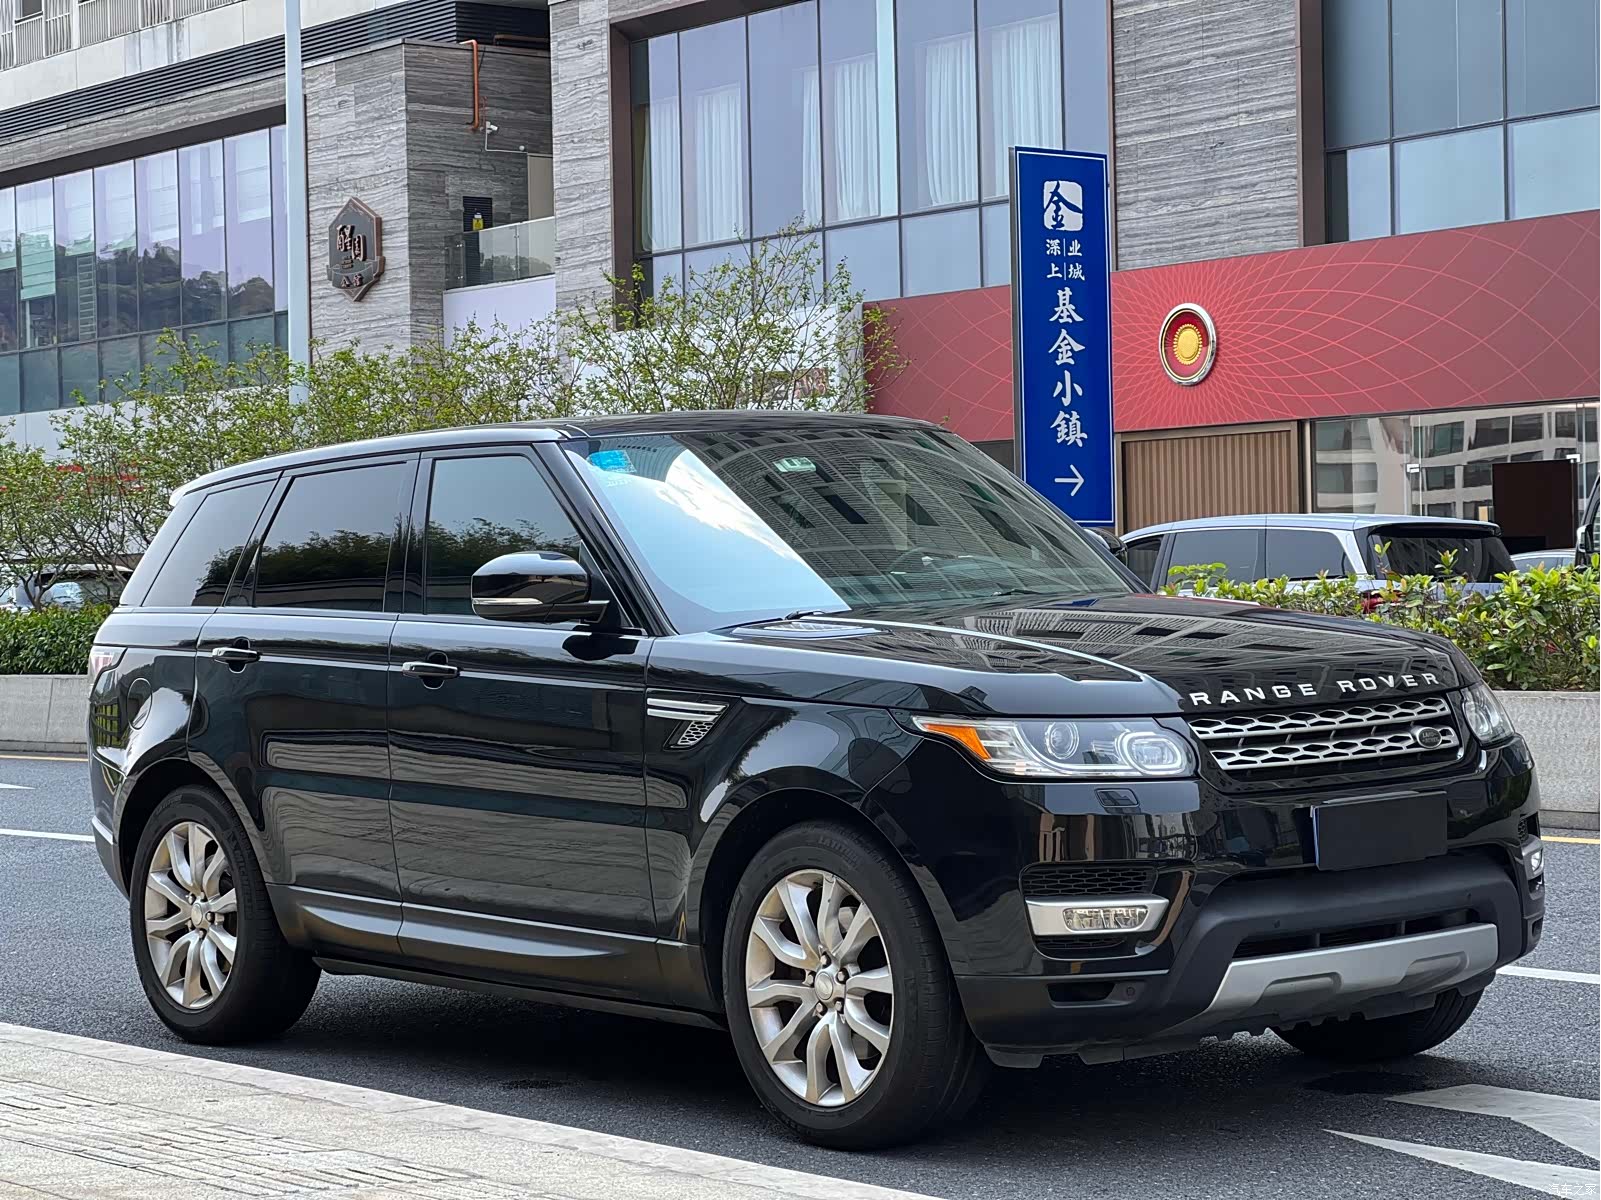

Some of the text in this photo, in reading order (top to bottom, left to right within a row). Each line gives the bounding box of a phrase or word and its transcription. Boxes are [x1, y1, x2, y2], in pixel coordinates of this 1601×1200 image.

[1048, 287, 1088, 447] 基金小鎮
[1189, 672, 1439, 706] RANGE ROVER
